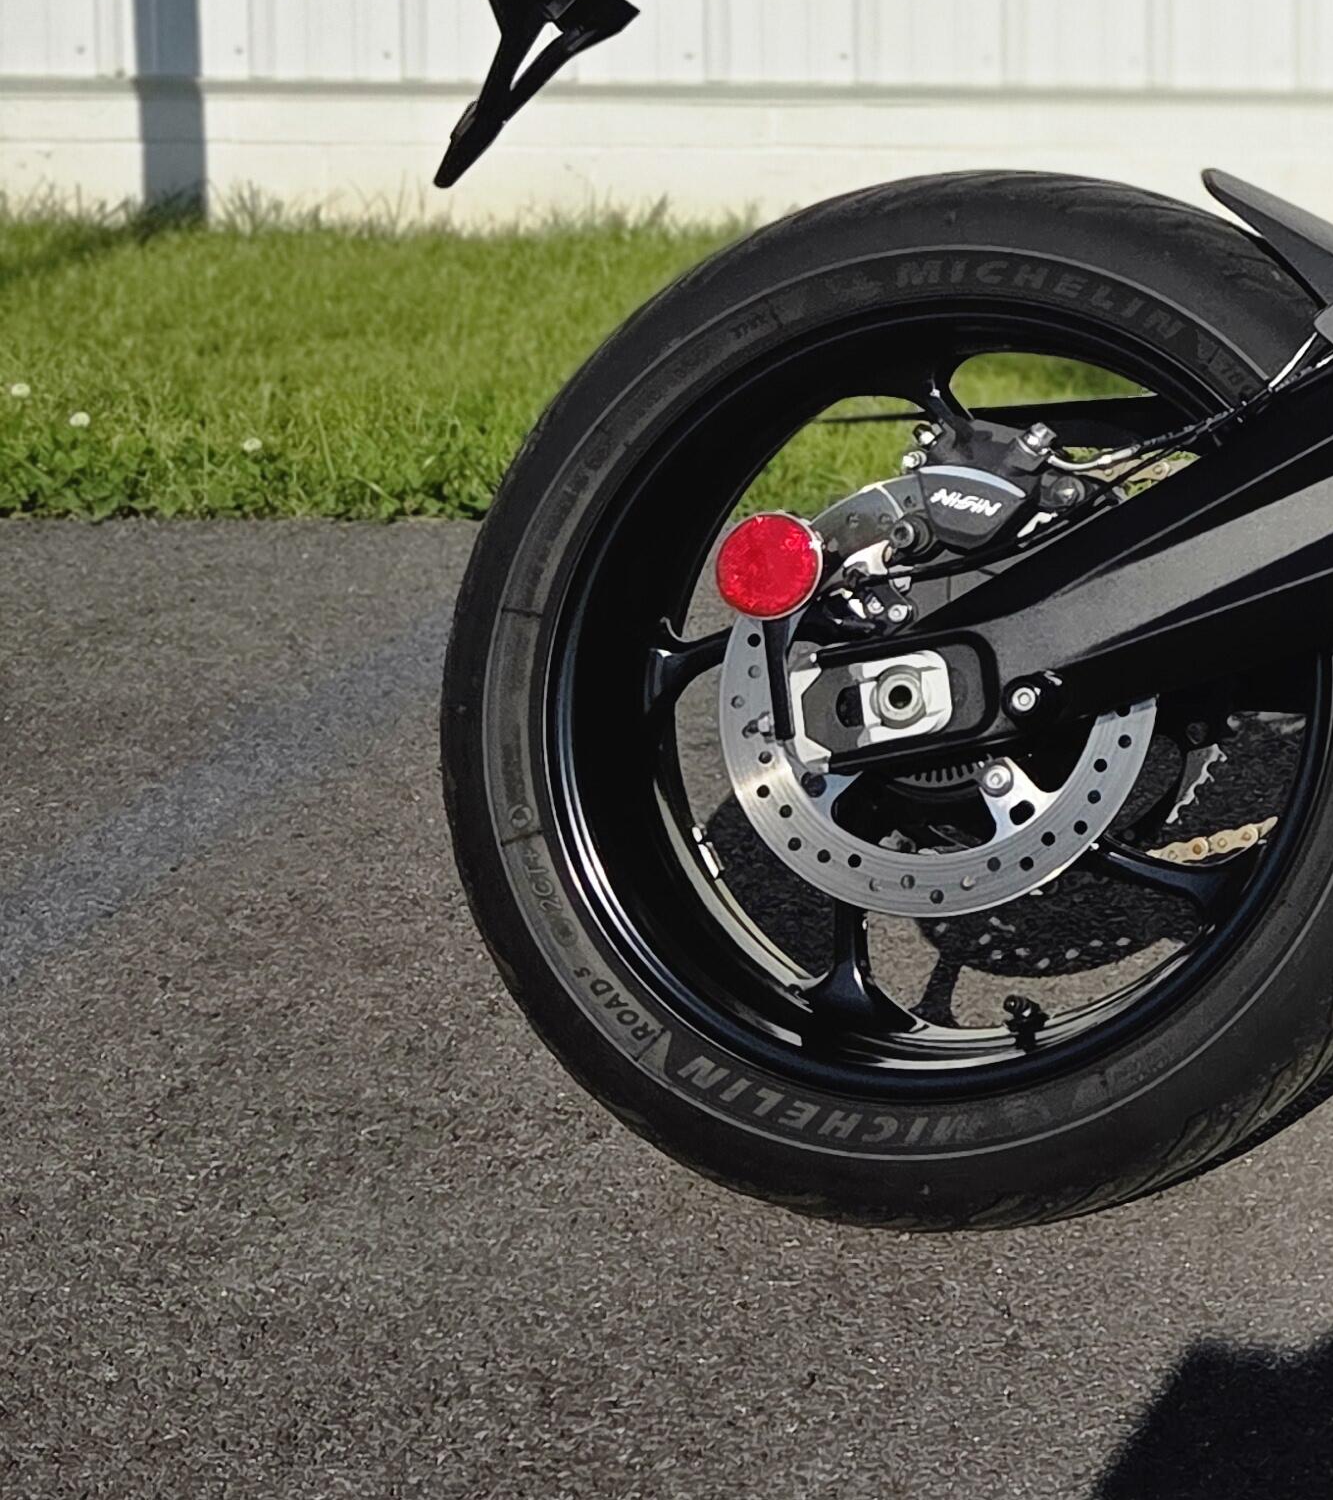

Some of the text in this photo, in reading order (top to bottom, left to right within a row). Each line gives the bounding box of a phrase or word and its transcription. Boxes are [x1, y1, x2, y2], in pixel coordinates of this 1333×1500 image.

[895, 257, 1188, 341] MICHELIN
[930, 487, 1002, 519] NISSIN
[676, 1054, 984, 1145] MICHELIN
